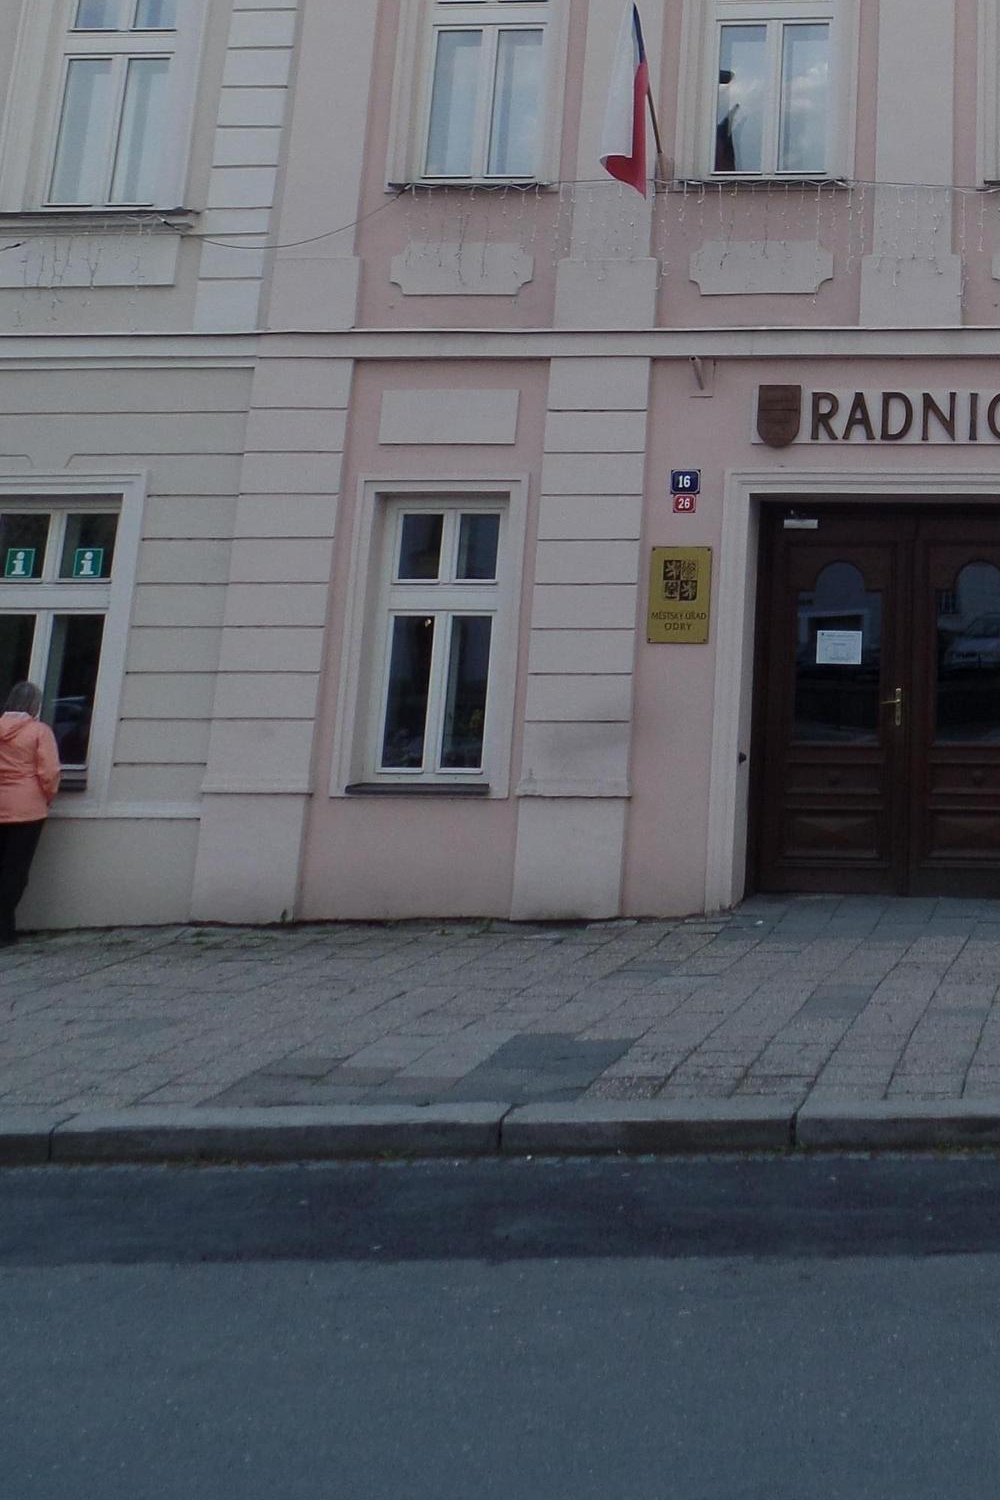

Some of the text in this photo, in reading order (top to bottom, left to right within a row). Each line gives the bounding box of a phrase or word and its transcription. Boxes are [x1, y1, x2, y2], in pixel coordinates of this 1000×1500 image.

[678, 475, 691, 488] 16
[678, 497, 690, 509] 26
[664, 622, 693, 632] ODRY
